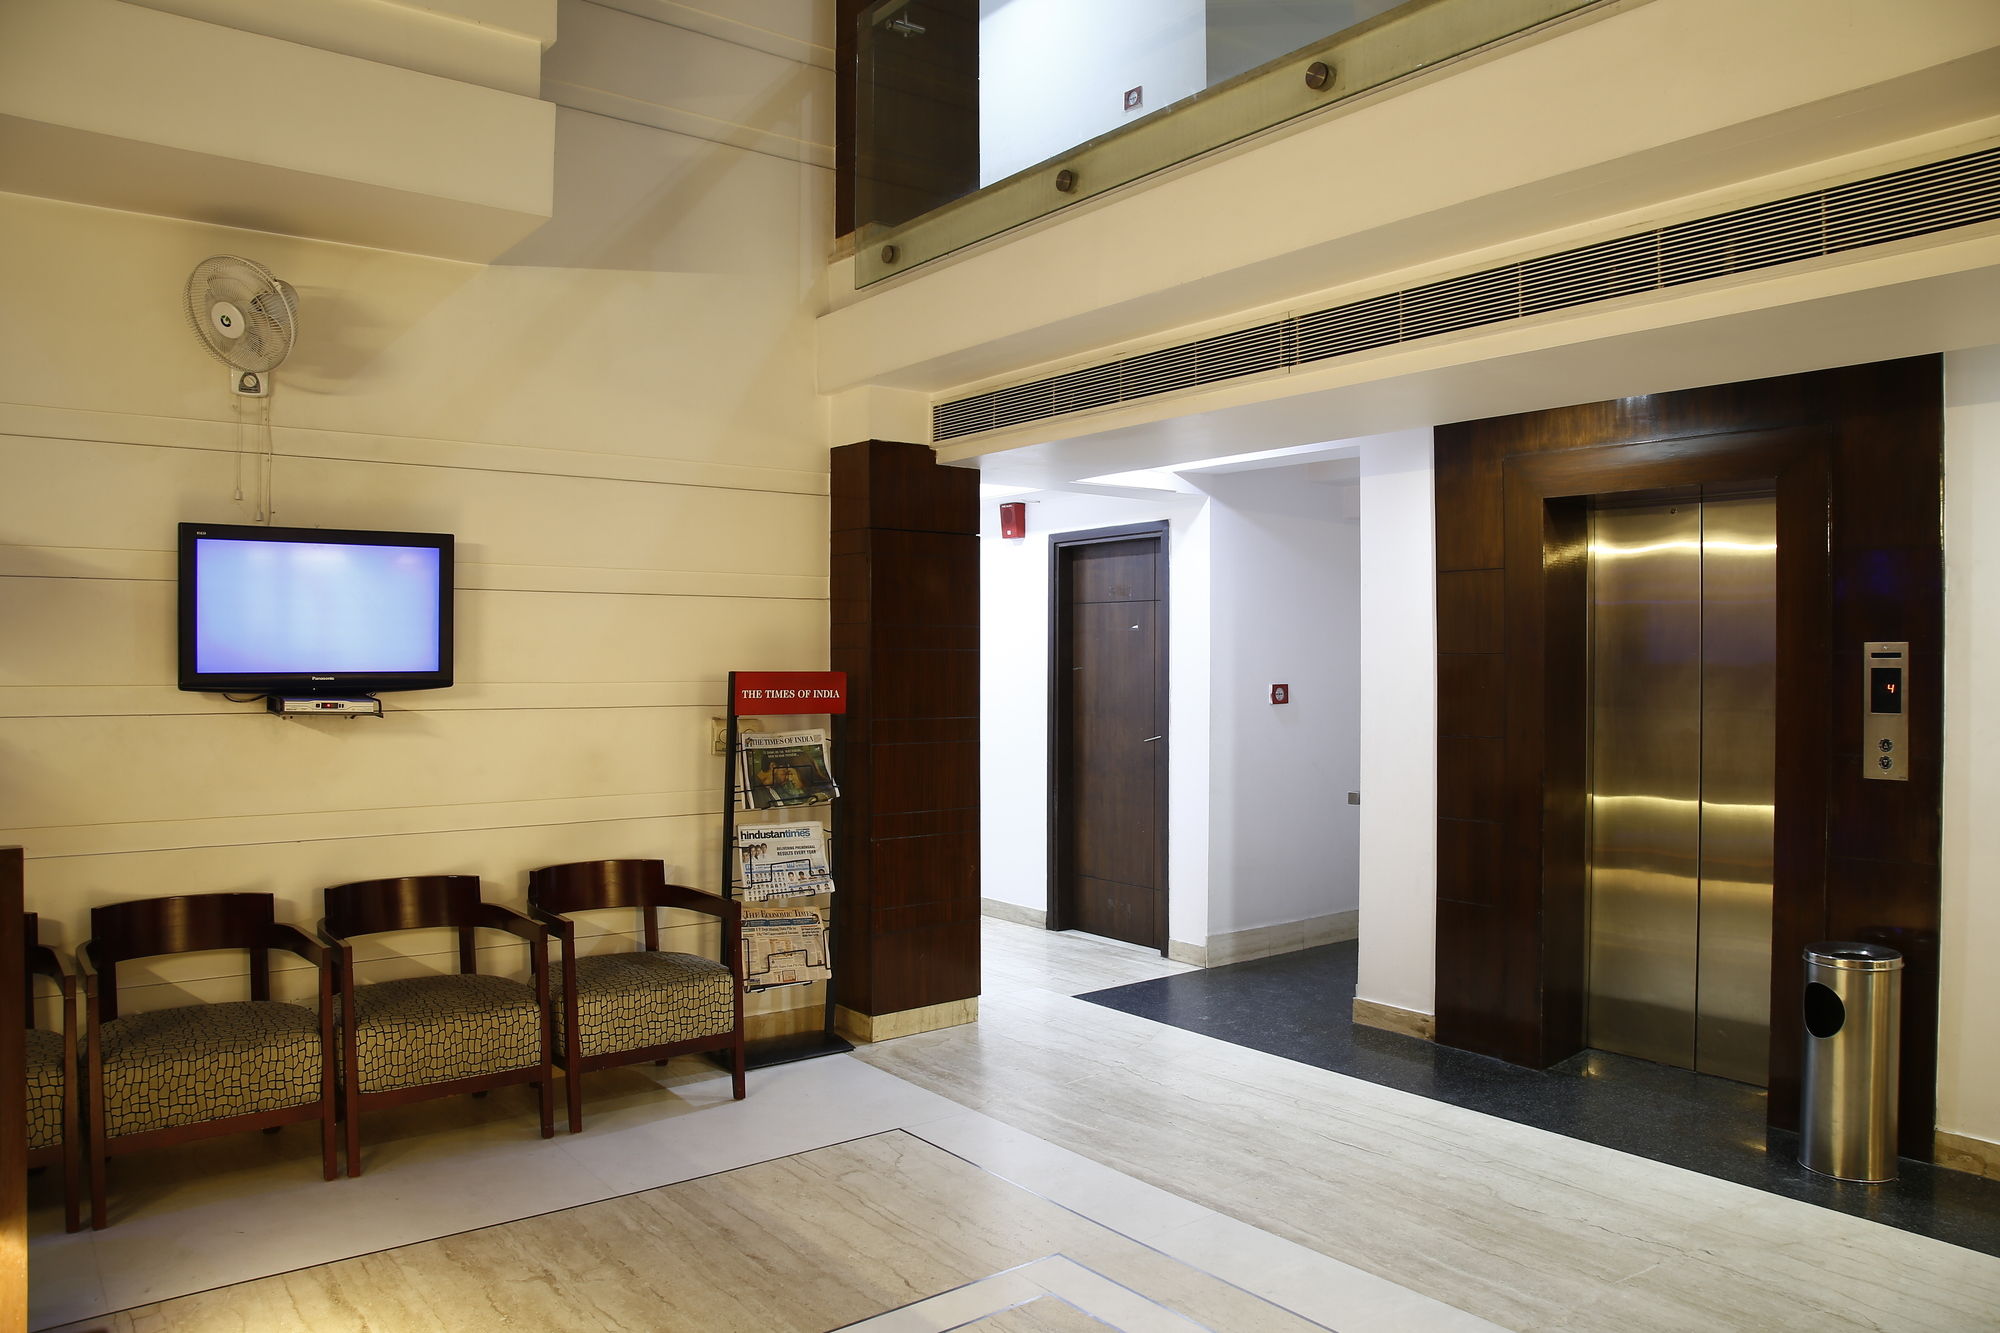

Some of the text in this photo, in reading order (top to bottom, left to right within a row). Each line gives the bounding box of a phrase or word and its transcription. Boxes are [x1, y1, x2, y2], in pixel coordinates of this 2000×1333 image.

[741, 689, 840, 698] THE TIMES OF INDIA
[1888, 684, 1894, 694] 4
[752, 738, 763, 746] THE
[763, 737, 784, 746] TIMES
[794, 735, 814, 743] INDIA
[740, 829, 811, 840] hindustantimes
